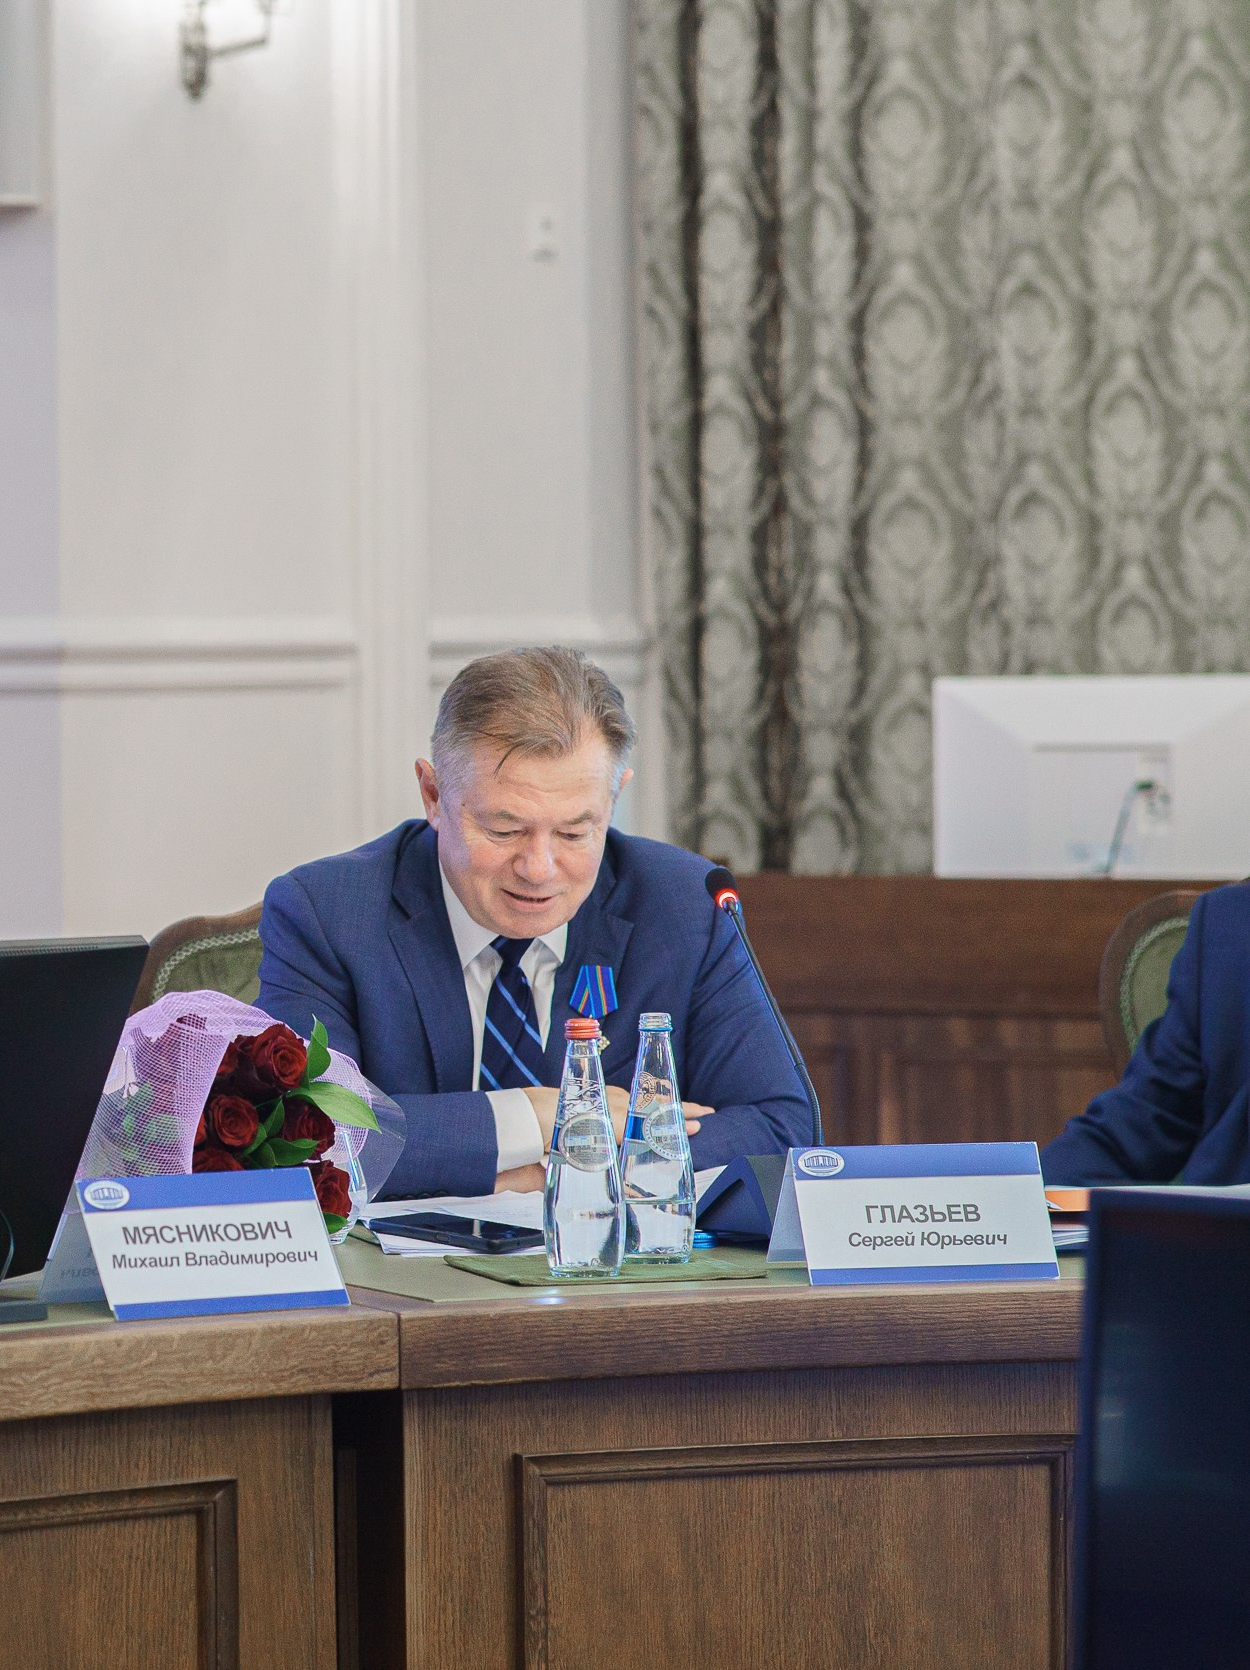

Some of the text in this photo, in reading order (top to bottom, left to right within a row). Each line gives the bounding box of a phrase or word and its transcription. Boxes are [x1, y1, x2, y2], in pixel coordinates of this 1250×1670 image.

[865, 1203, 981, 1224] ГЛАЗЬЕВ
[121, 1221, 293, 1245] МЯСНИКОВИЧ
[848, 1231, 1008, 1250] Сергей Юрьевич
[112, 1250, 319, 1270] Михаил Владимирович
